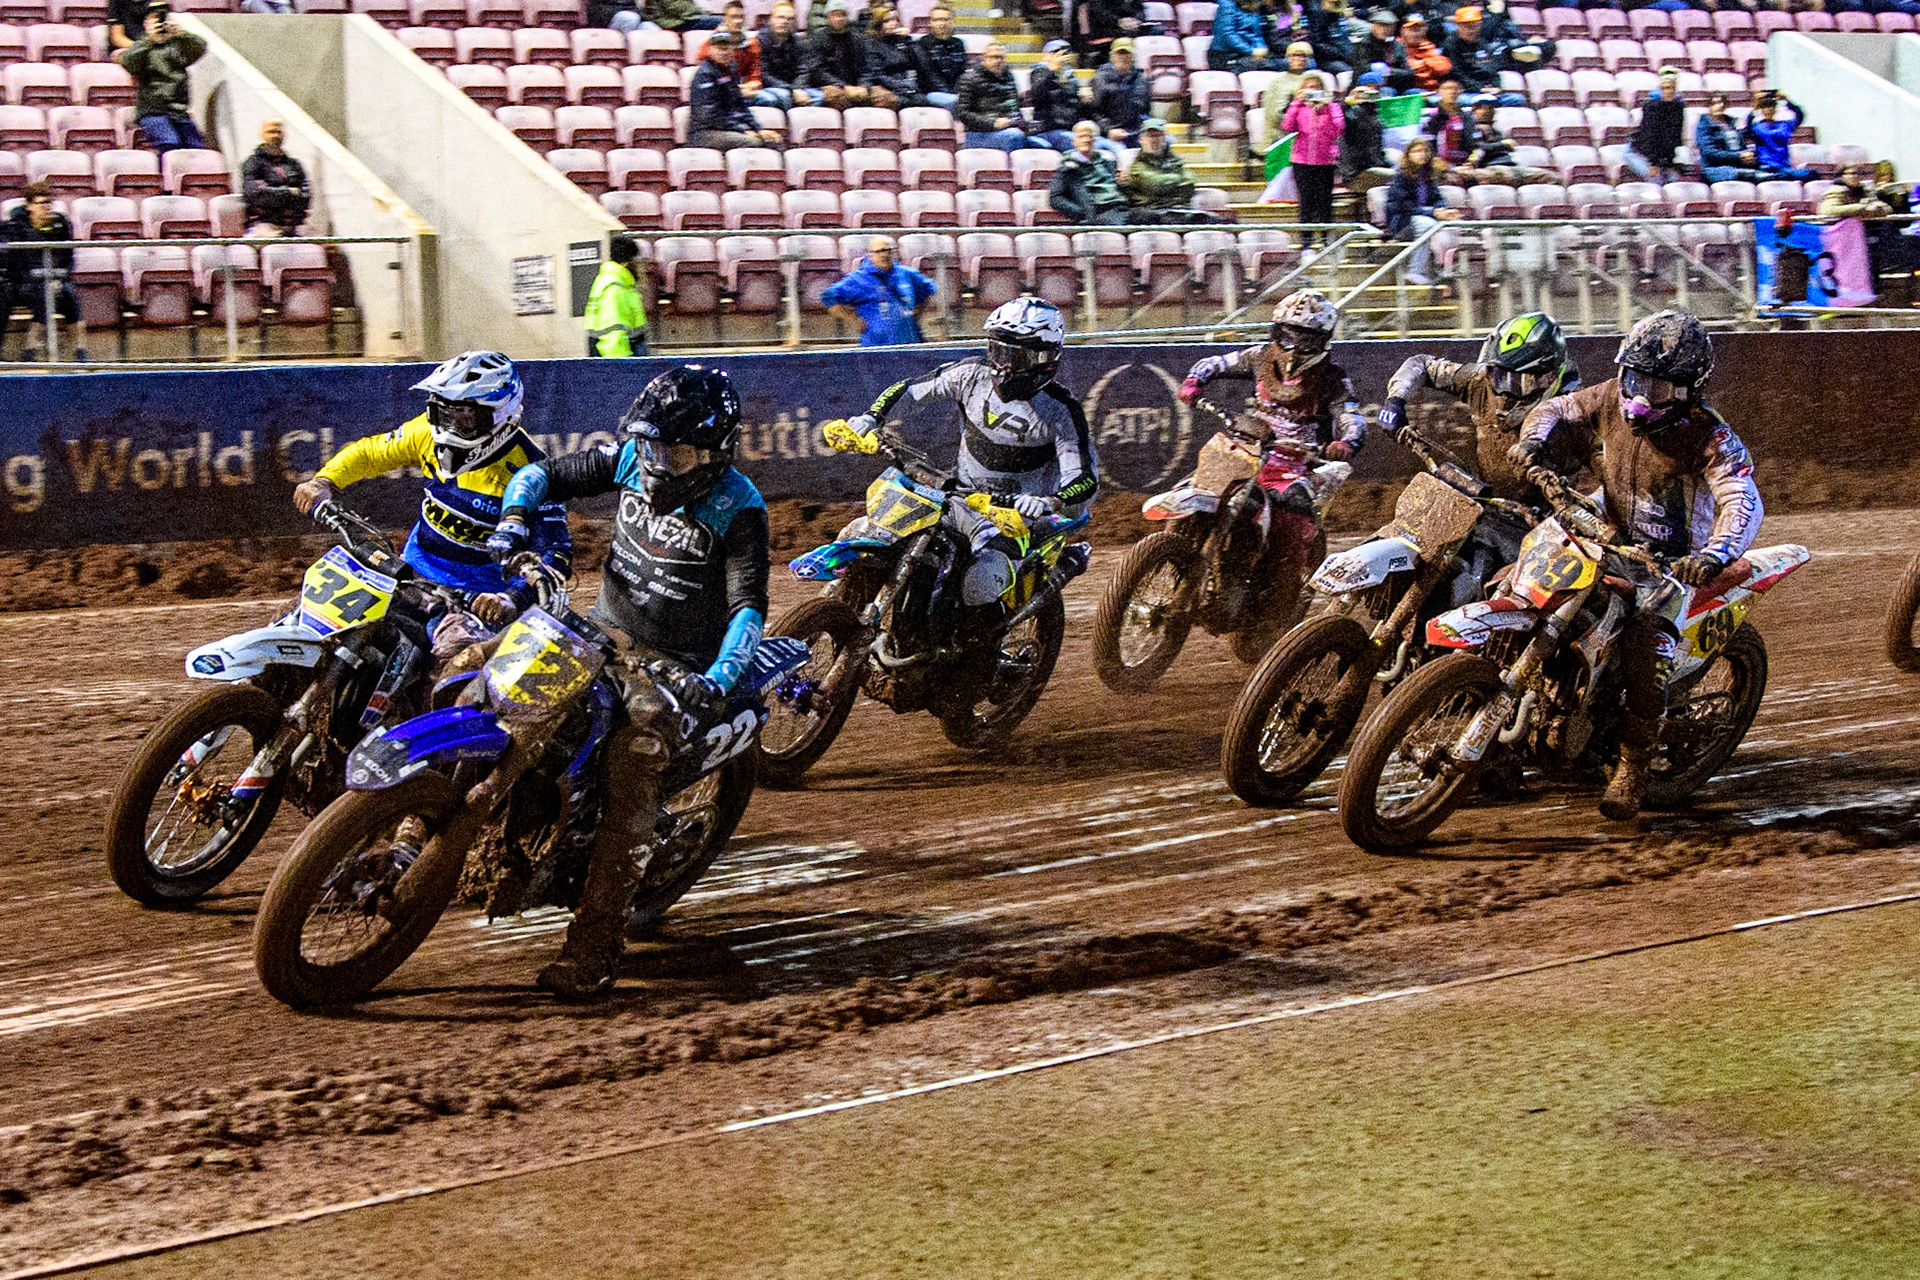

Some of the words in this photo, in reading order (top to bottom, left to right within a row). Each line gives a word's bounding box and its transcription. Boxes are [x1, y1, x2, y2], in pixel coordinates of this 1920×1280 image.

[1378, 409, 1397, 424] FLY
[65, 430, 254, 493] World
[471, 498, 500, 515] orio
[304, 568, 383, 624] 34
[1699, 608, 1734, 652] 69
[701, 709, 758, 772] 22
